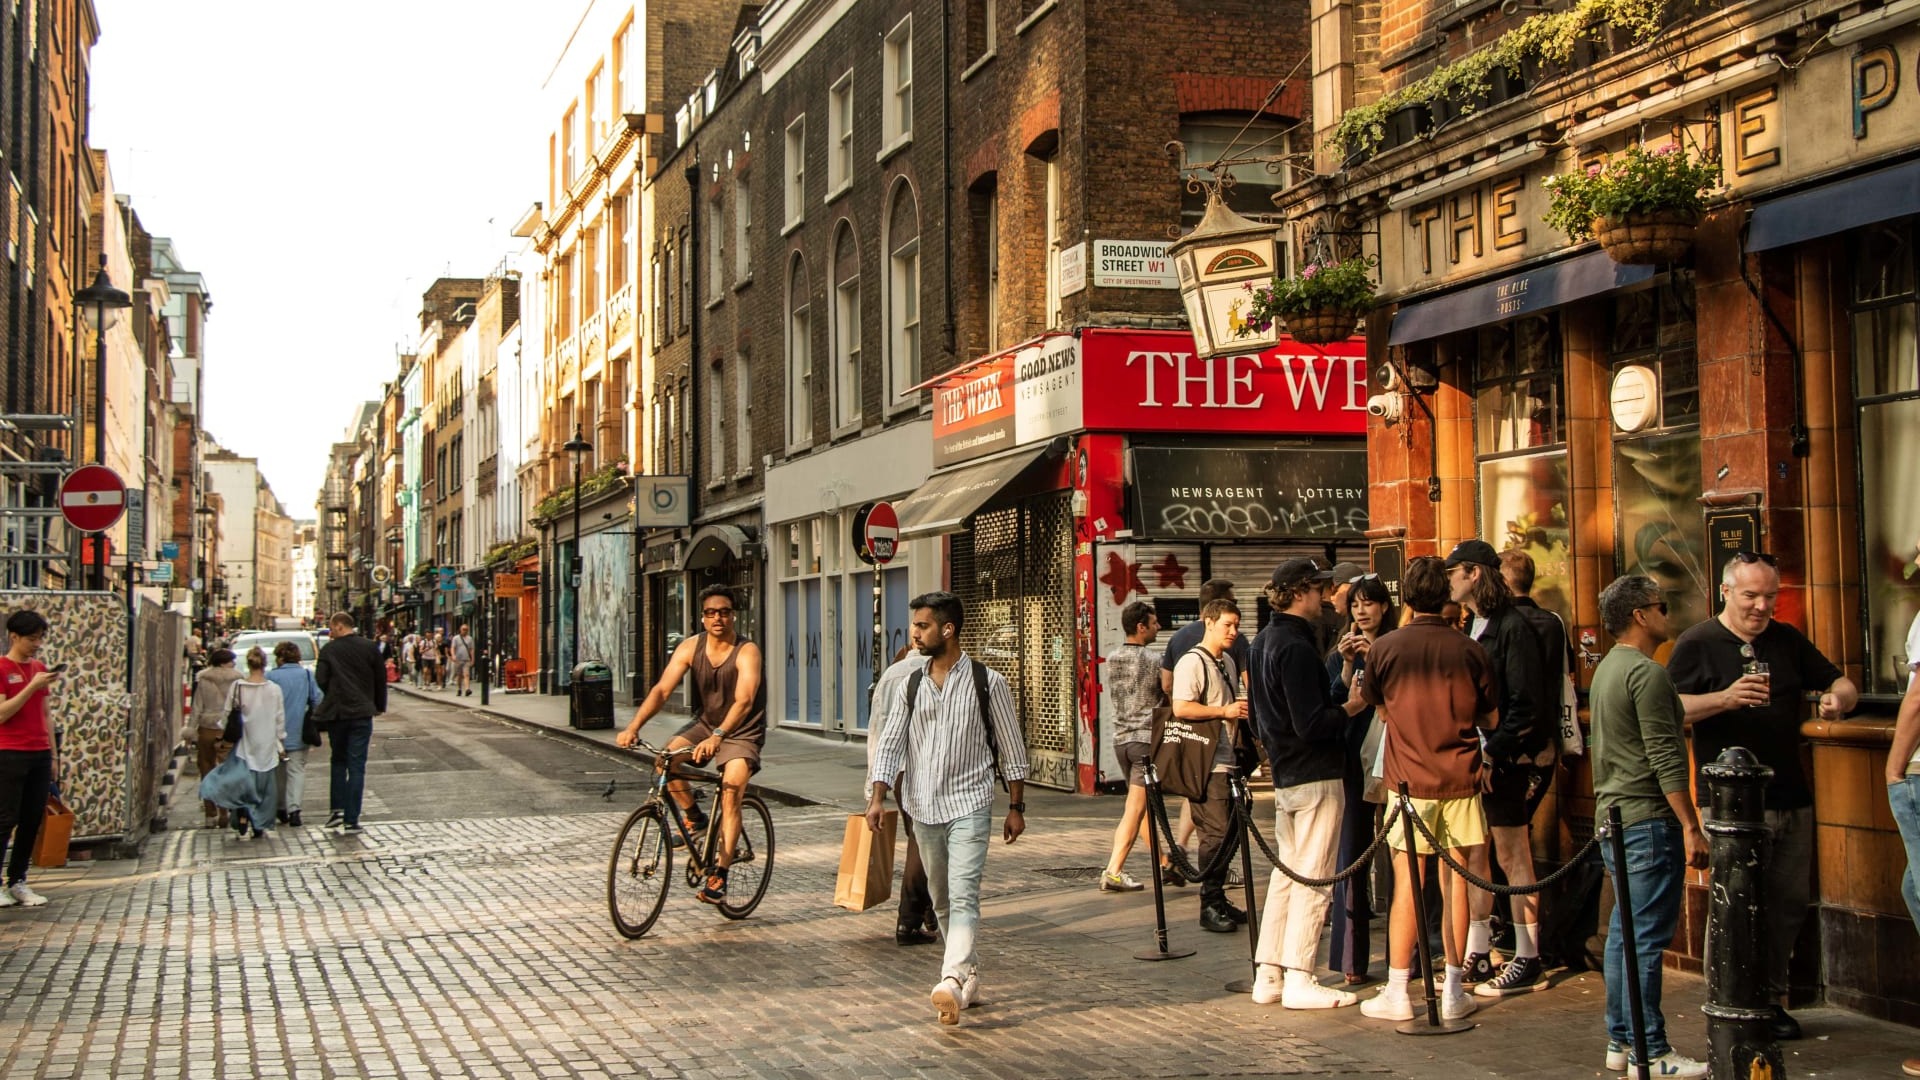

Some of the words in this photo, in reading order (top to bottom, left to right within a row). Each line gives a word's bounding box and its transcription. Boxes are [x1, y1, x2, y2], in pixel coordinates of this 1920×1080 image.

[1409, 174, 1527, 274] THE
[1102, 260, 1144, 272] STREET
[1148, 261, 1165, 273] W1
[1497, 284, 1509, 298] THE
[1021, 357, 1047, 382] GOOD
[1048, 346, 1075, 373] NEWS
[1126, 351, 1264, 408] THE
[940, 385, 965, 427] THE
[966, 371, 1003, 418] WEEK
[1021, 372, 1075, 400] NEWSAGENT
[1171, 487, 1264, 498] NEWSAGENT
[1297, 488, 1363, 499] LOTTERY
[787, 632, 796, 668] A
